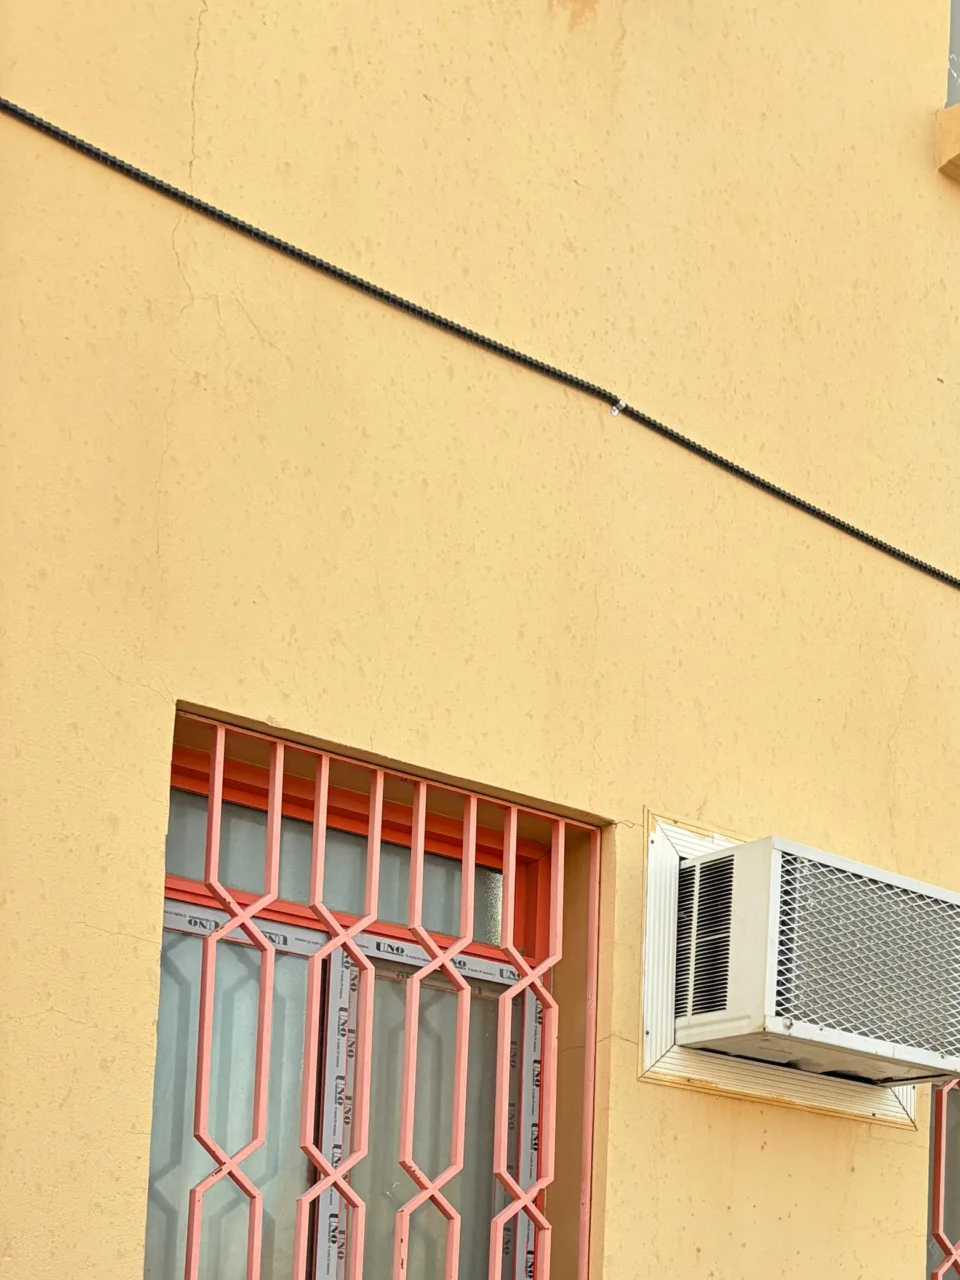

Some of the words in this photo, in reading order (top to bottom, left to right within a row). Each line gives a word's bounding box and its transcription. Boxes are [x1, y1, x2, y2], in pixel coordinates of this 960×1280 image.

[187, 917, 220, 932] UNO
[375, 941, 405, 957] UNO
[337, 1006, 348, 1038] UNO
[347, 1027, 356, 1059] UNO
[532, 1059, 542, 1088] UNO
[335, 1074, 346, 1106] UNO
[343, 1094, 353, 1126] UNO
[530, 1122, 540, 1152] UNO
[328, 1212, 340, 1245] UNO
[336, 1229, 347, 1261] UNO
[525, 1250, 534, 1279] UNO
